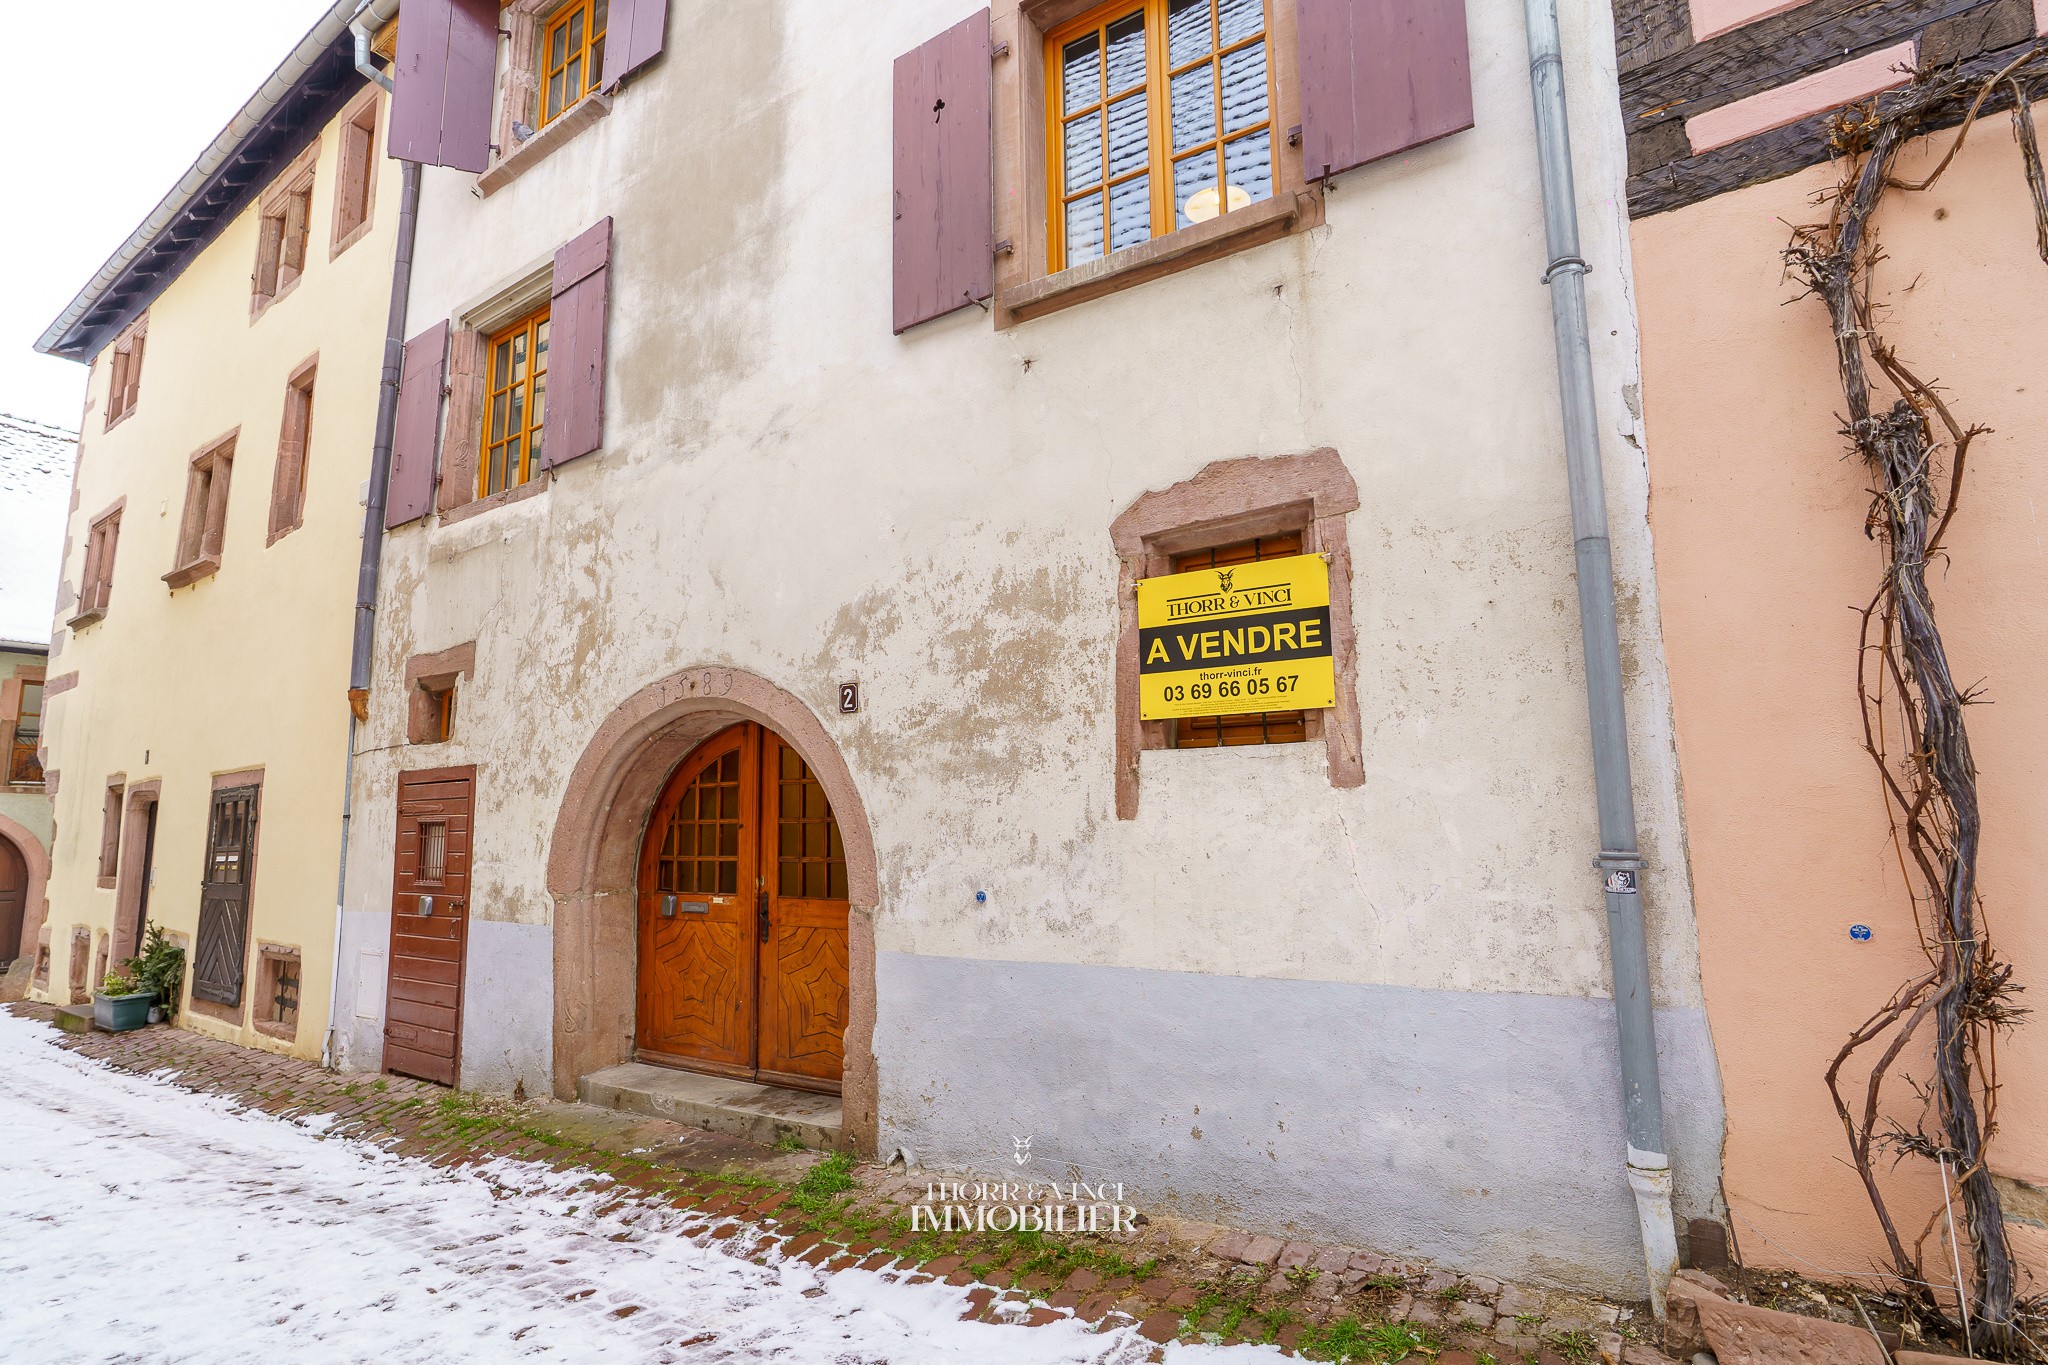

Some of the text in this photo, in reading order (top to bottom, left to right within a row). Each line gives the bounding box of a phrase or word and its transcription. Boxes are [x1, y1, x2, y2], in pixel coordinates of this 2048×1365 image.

[1166, 588, 1292, 617] THORR & VINCI
[1146, 618, 1323, 665] A VENDRE
[1199, 667, 1263, 681] thorr-vinci.fr
[843, 688, 853, 708] 2
[1163, 675, 1299, 702] 03 69 66 05 67
